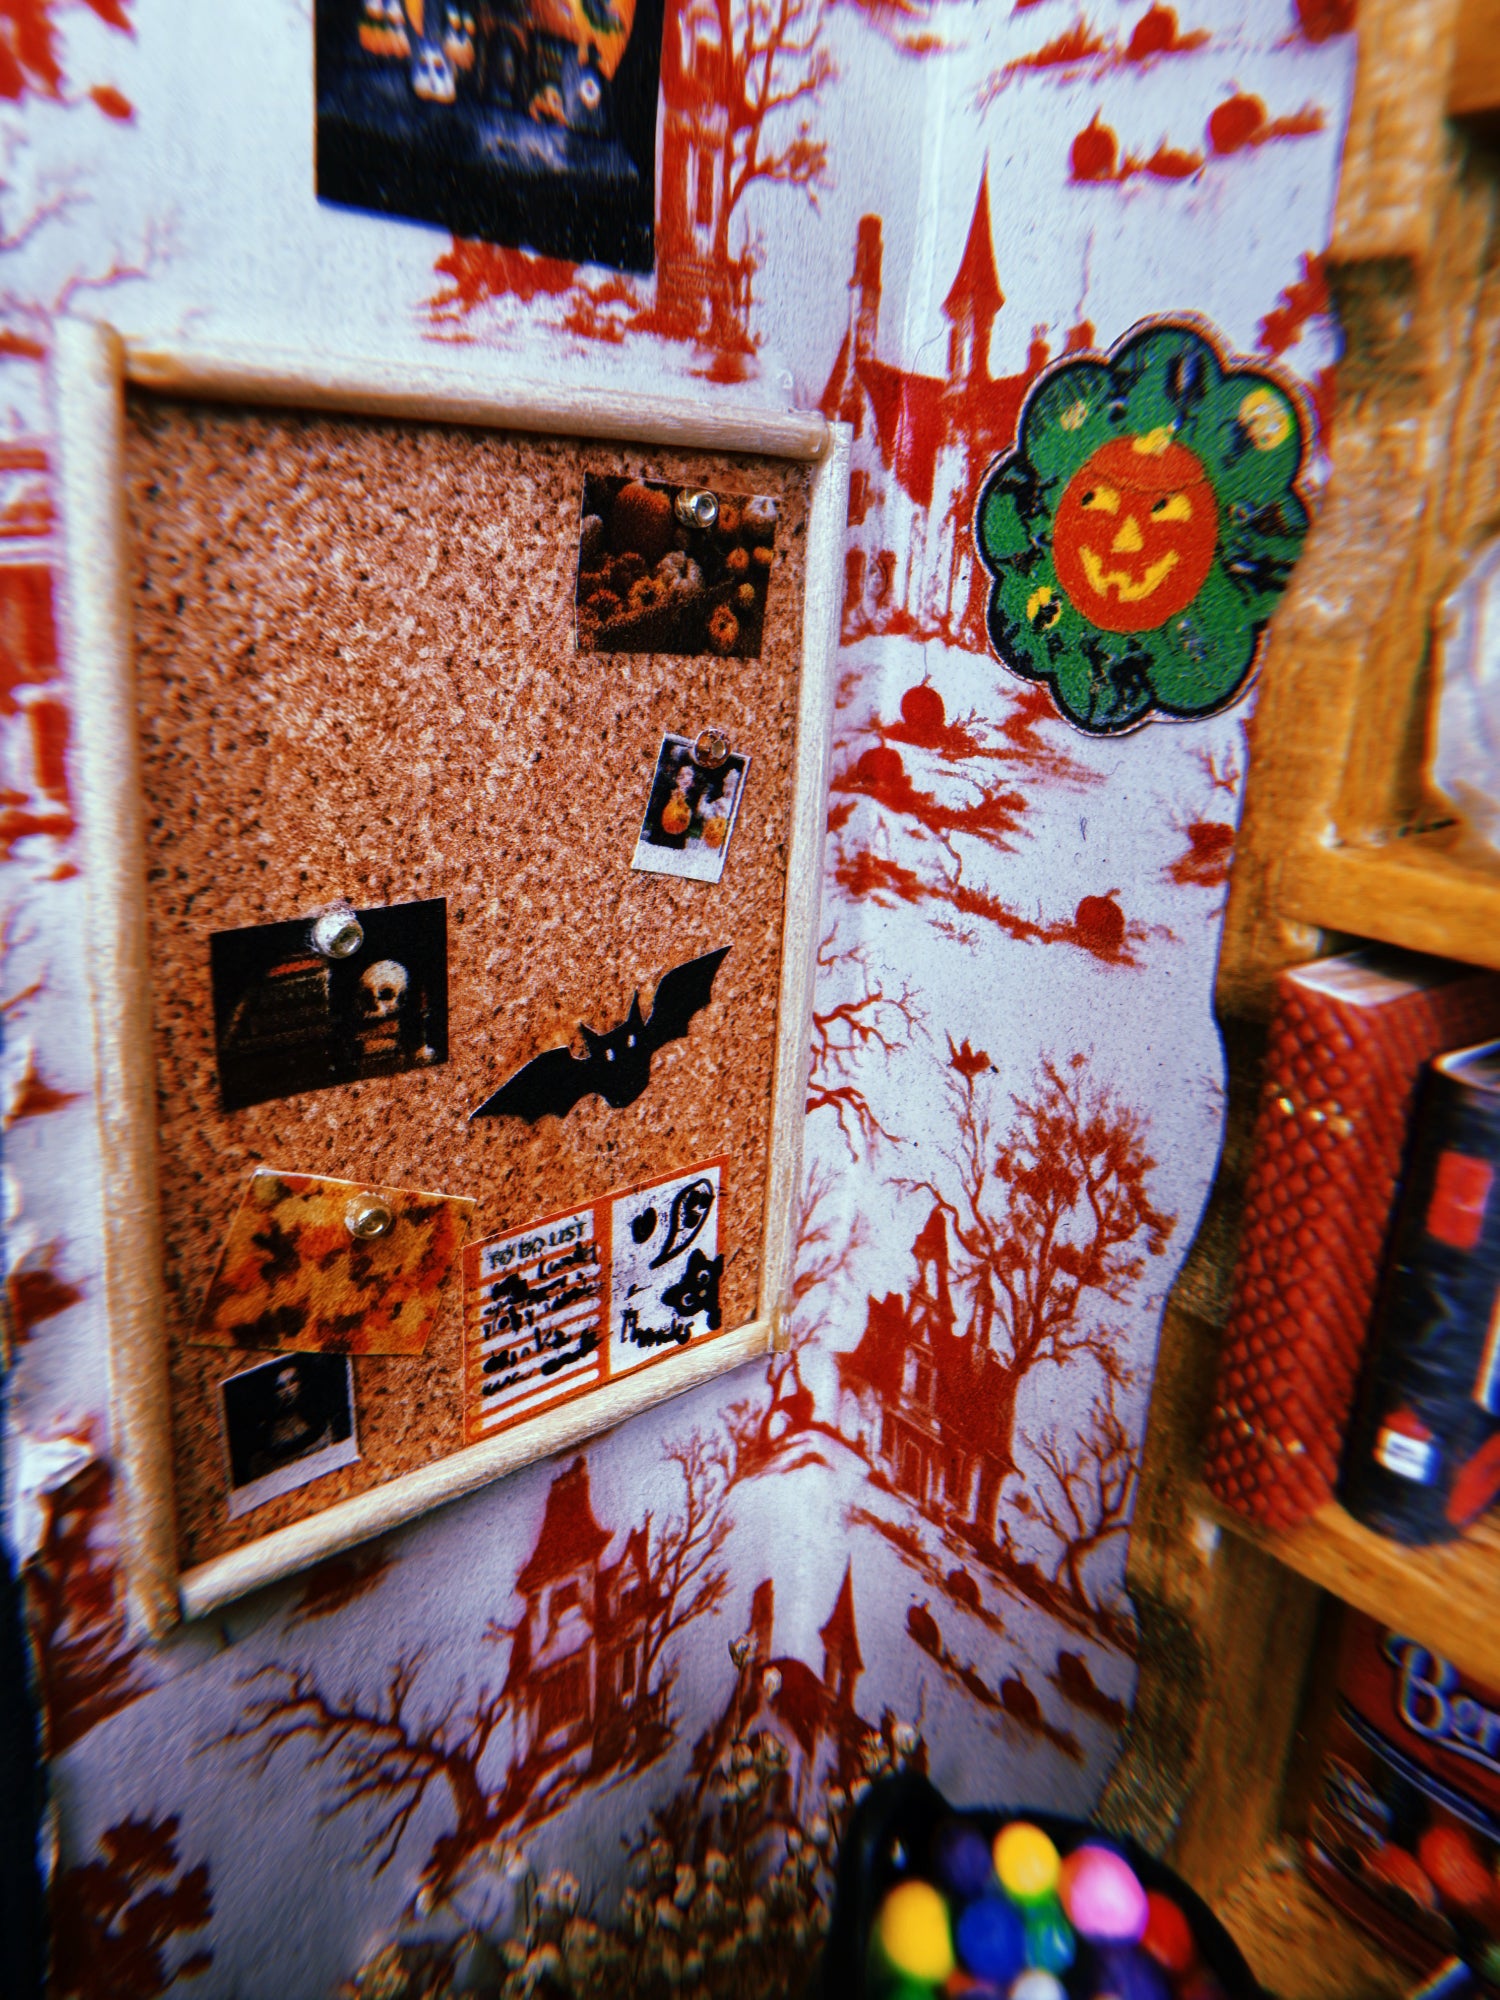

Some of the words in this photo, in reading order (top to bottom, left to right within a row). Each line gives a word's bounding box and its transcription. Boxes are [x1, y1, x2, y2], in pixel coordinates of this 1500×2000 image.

[490, 1244, 515, 1269] TO
[519, 1236, 546, 1260] DO
[548, 1221, 587, 1246] LIST
